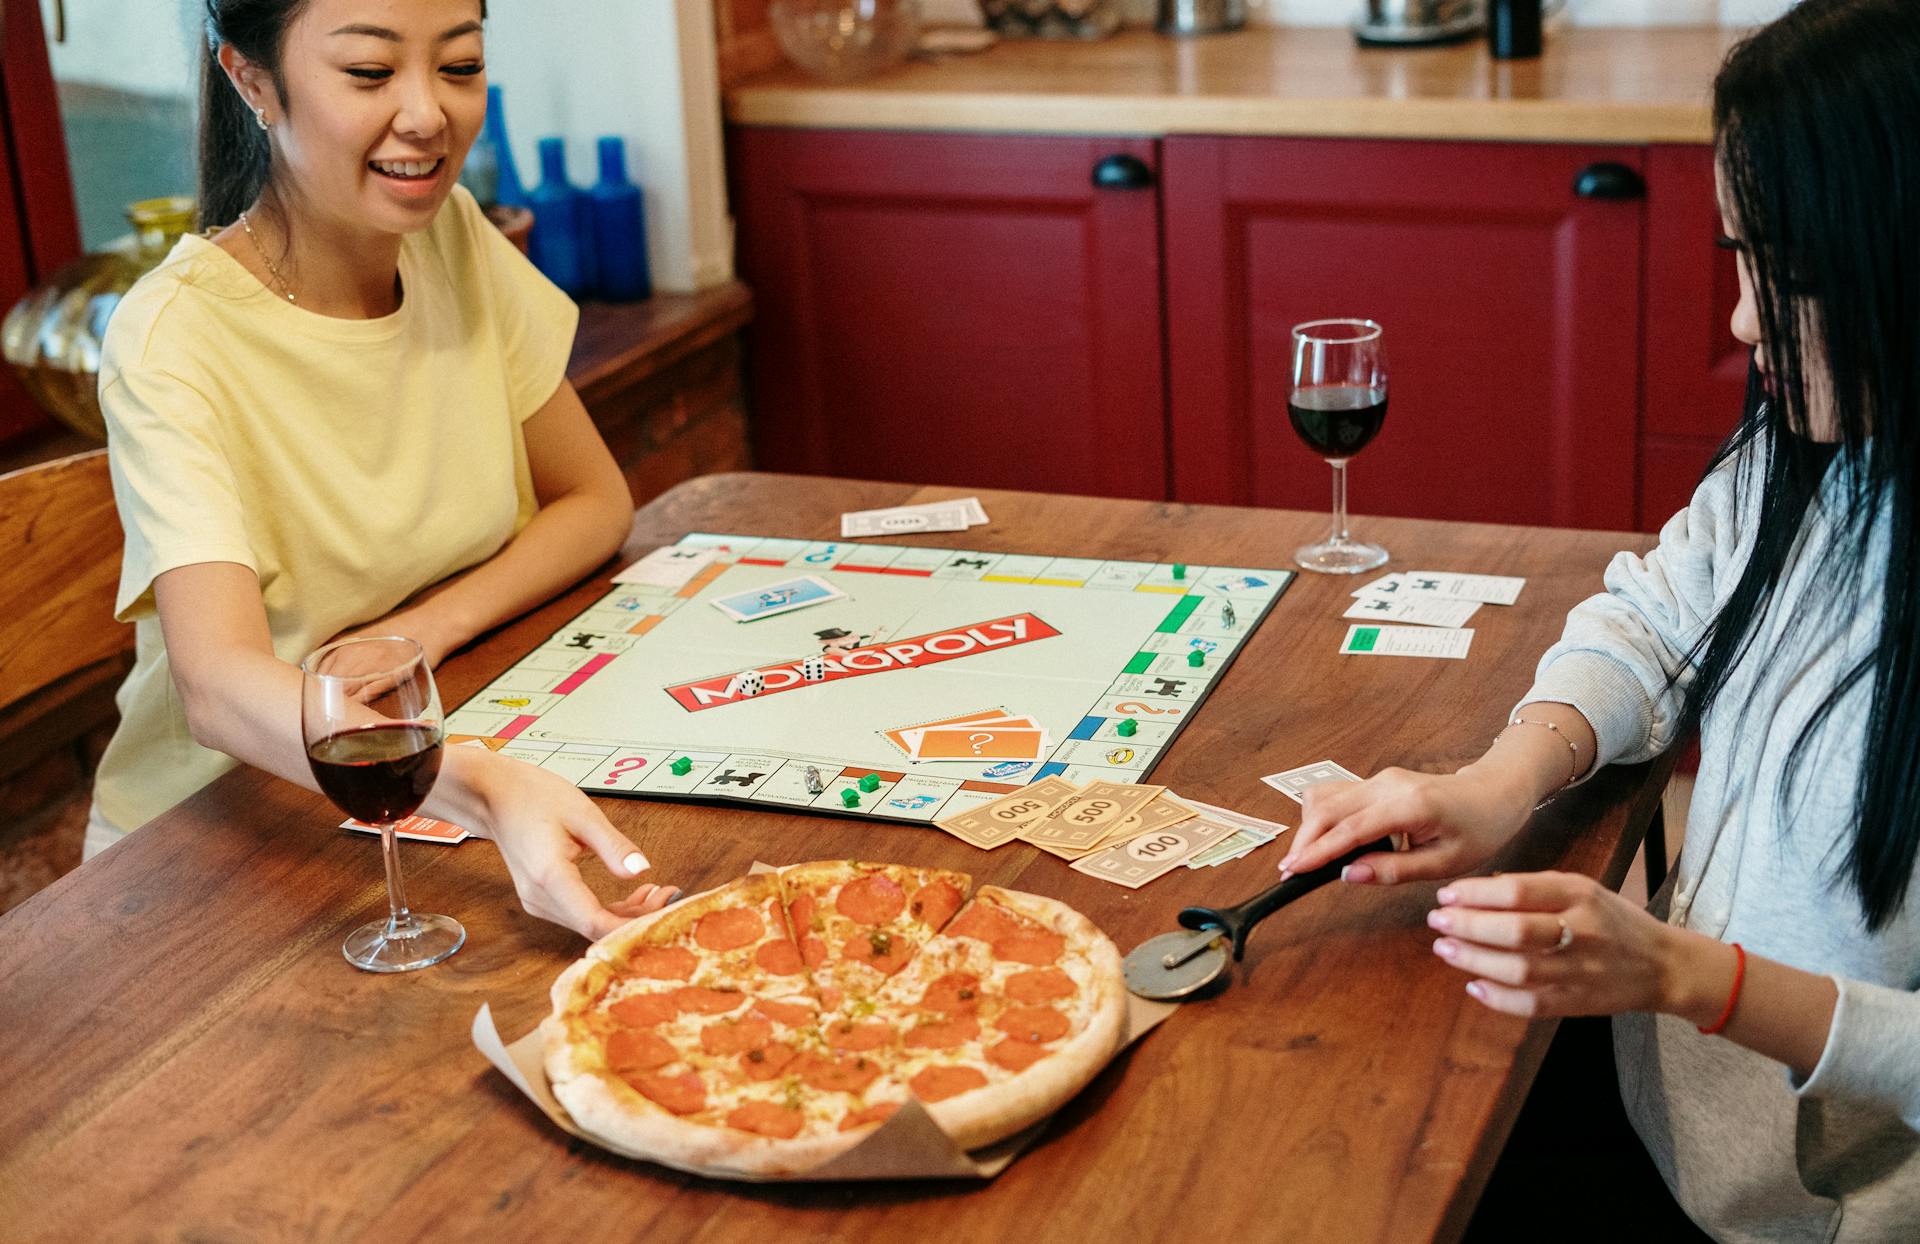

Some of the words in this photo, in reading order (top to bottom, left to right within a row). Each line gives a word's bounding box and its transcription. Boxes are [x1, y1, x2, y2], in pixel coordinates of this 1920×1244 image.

[997, 800, 1042, 820] 500
[1074, 800, 1112, 824] 500
[1137, 835, 1180, 857] 100
